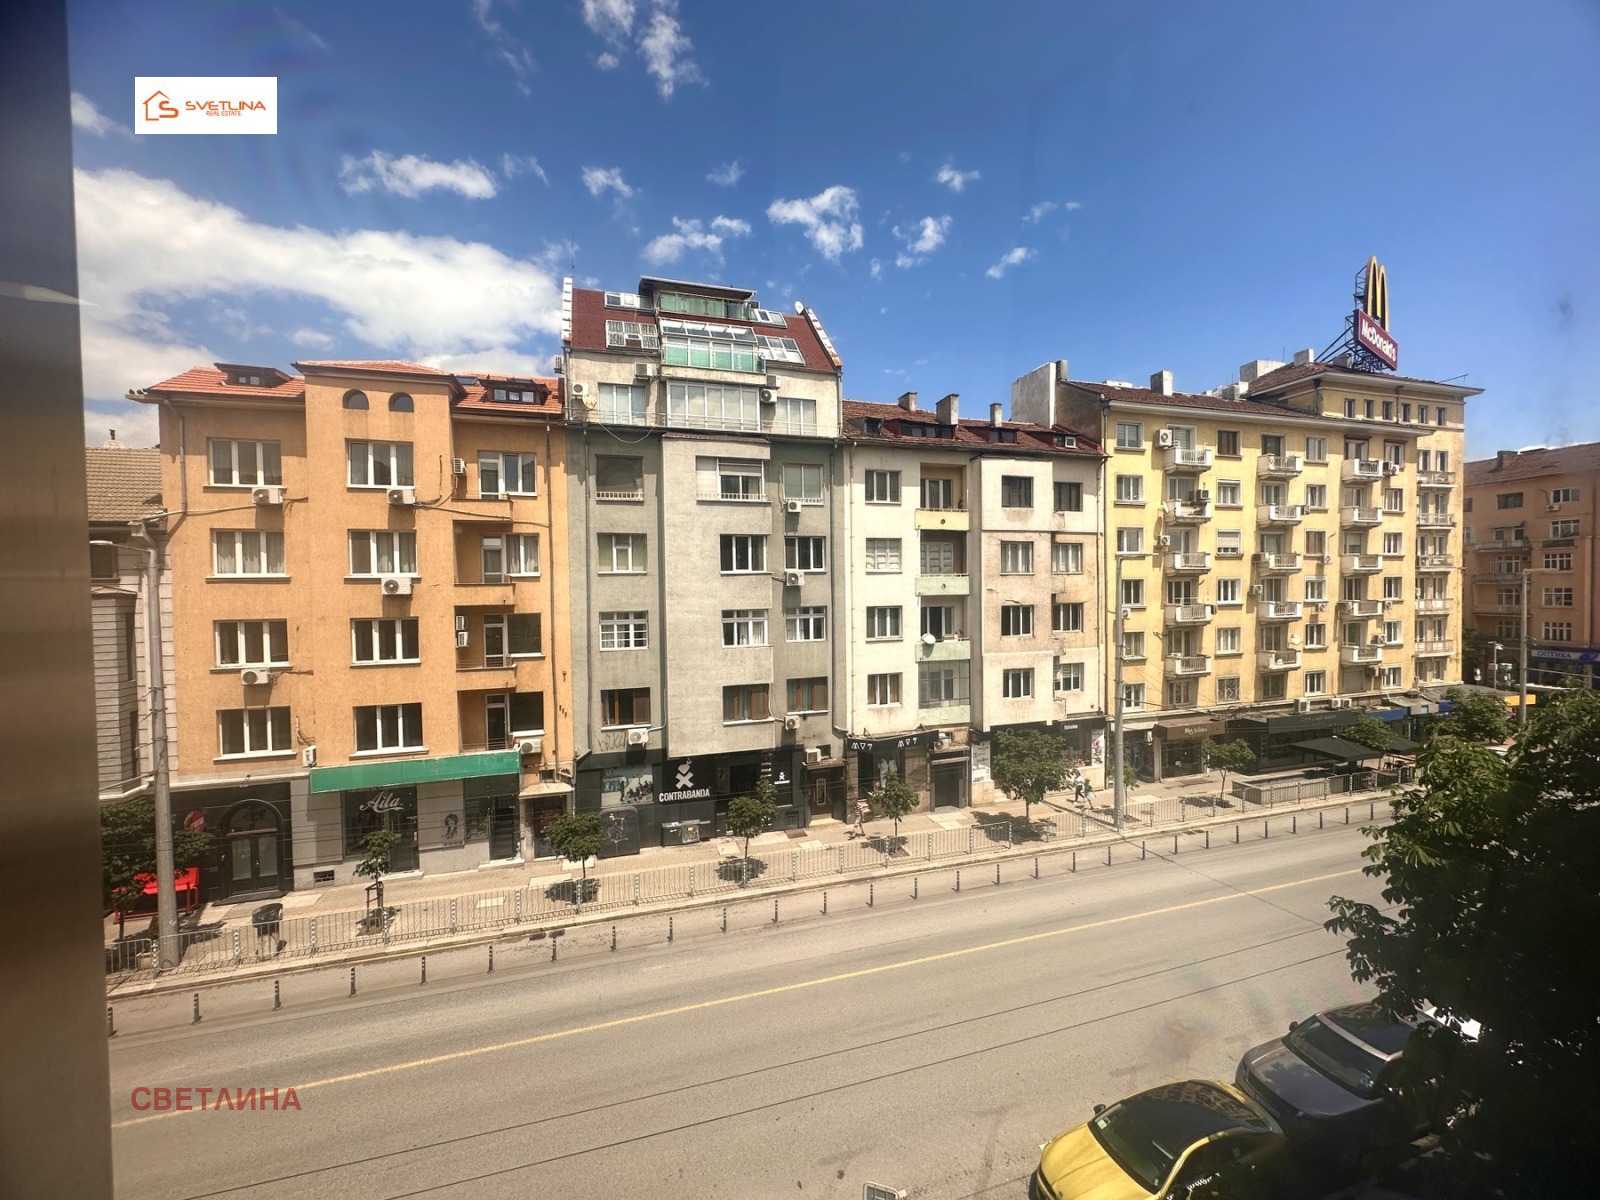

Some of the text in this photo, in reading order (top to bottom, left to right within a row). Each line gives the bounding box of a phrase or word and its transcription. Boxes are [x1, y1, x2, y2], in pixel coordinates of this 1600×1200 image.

[1361, 318, 1396, 362] McDonald's
[1537, 650, 1572, 659] ОПТИКА
[658, 787, 710, 803] CONTRABANDA
